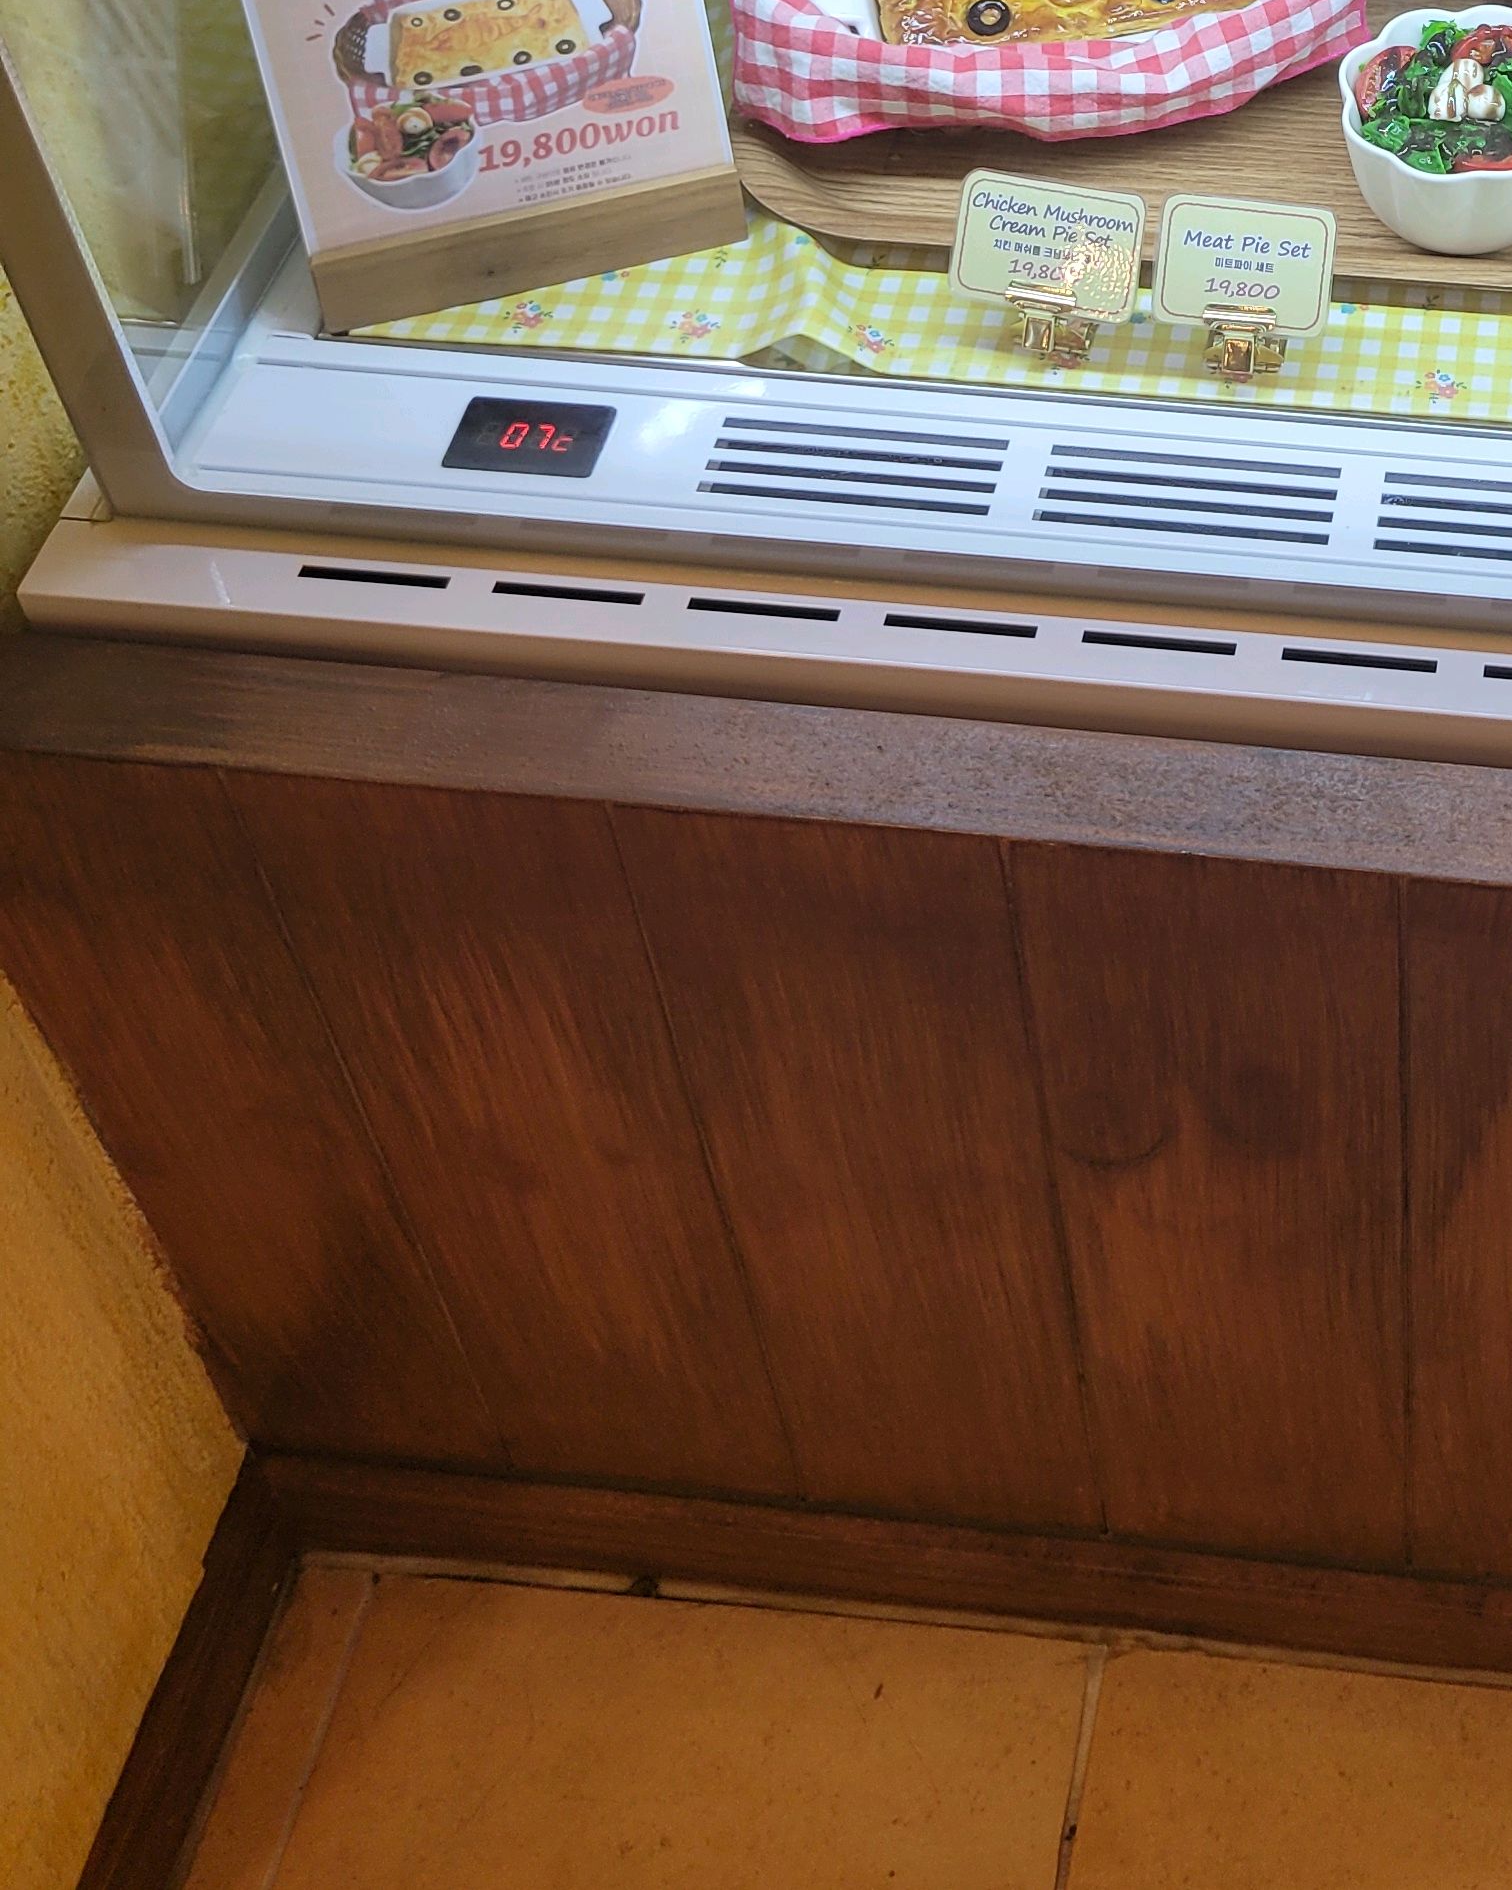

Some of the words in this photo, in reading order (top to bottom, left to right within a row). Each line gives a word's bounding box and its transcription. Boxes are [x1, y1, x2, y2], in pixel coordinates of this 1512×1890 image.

[478, 111, 680, 173] 19,800won
[972, 192, 1038, 217] Chicken
[1043, 204, 1134, 234] Mushroom
[989, 215, 1046, 238] Cream
[1053, 226, 1078, 243] Pie
[993, 239, 1011, 251] 치킨
[1014, 243, 1041, 256] 머쉬룸
[1183, 229, 1234, 250] Meat
[1241, 236, 1271, 254] Pie
[1277, 240, 1312, 259] Set
[1255, 261, 1274, 273] 세트
[1204, 277, 1281, 300] 19,800
